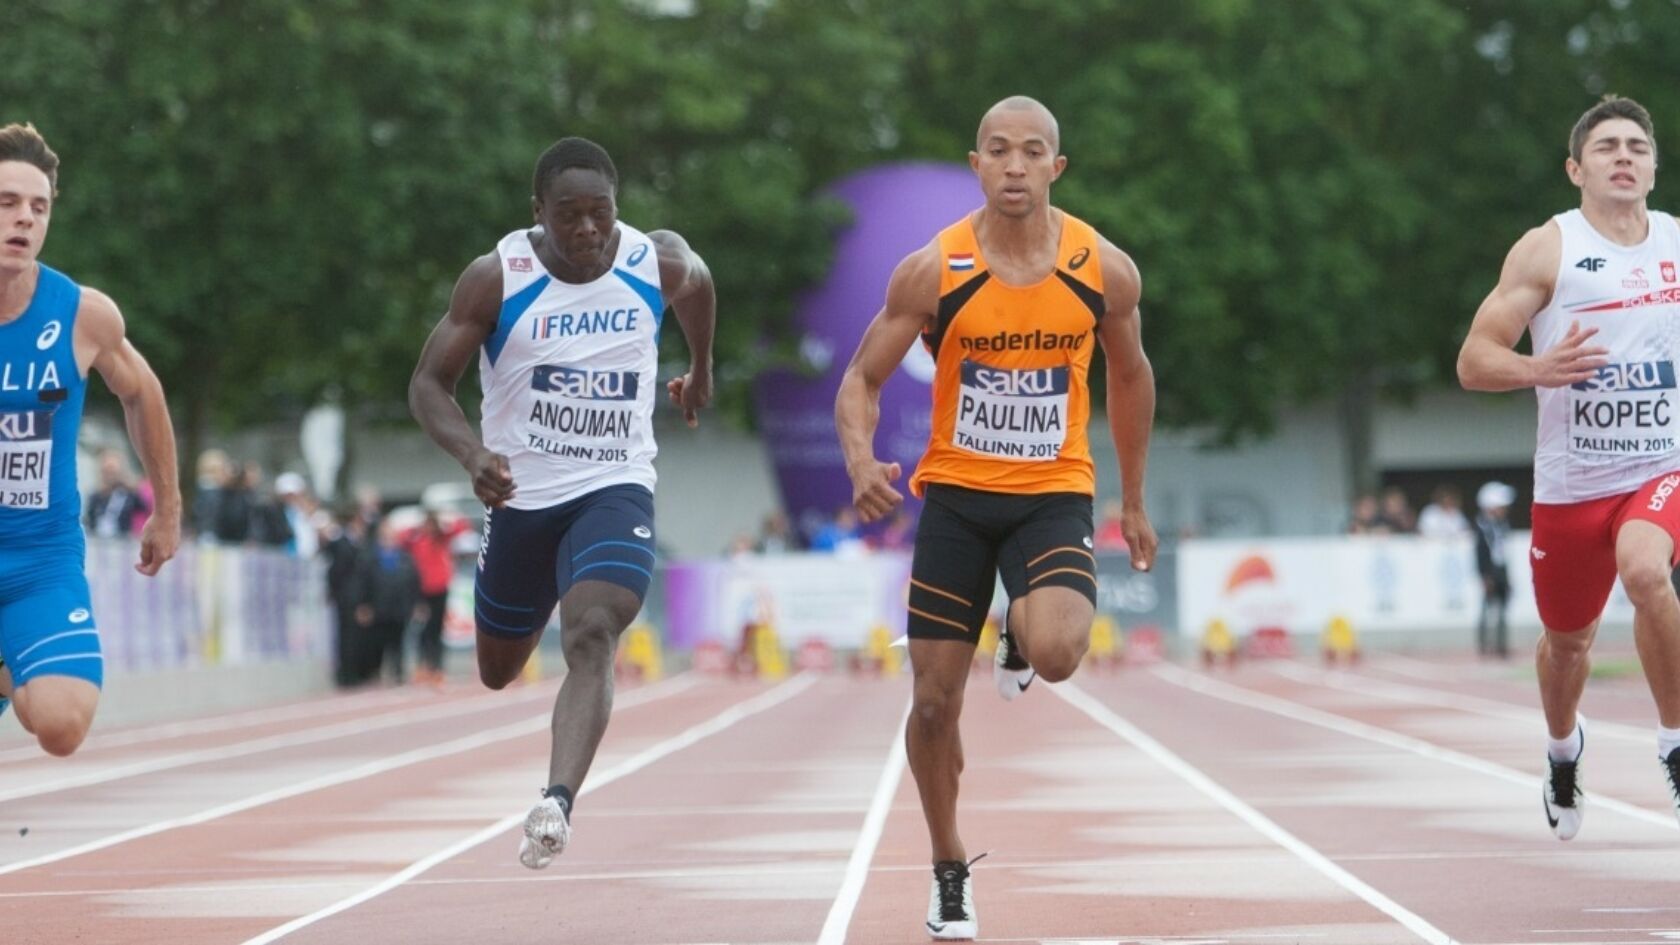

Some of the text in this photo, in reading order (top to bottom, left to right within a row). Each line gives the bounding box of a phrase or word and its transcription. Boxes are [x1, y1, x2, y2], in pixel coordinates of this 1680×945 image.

[1575, 257, 1607, 272] 4F
[546, 308, 639, 339] FRANCE
[960, 329, 1088, 351] nederland
[2, 361, 61, 391] LIA
[548, 369, 624, 399] saku
[974, 368, 1055, 395] saku
[529, 400, 632, 438] ANOUMAN
[960, 394, 1061, 433] PAULINA
[1574, 392, 1671, 428] KOPEĆ
[528, 433, 628, 461] TALLINN 2015
[957, 432, 1061, 457] TALLINN 2015
[1573, 436, 1675, 452] TALLINN 2015
[1, 451, 45, 481] IERI
[9, 491, 43, 506] 2015
